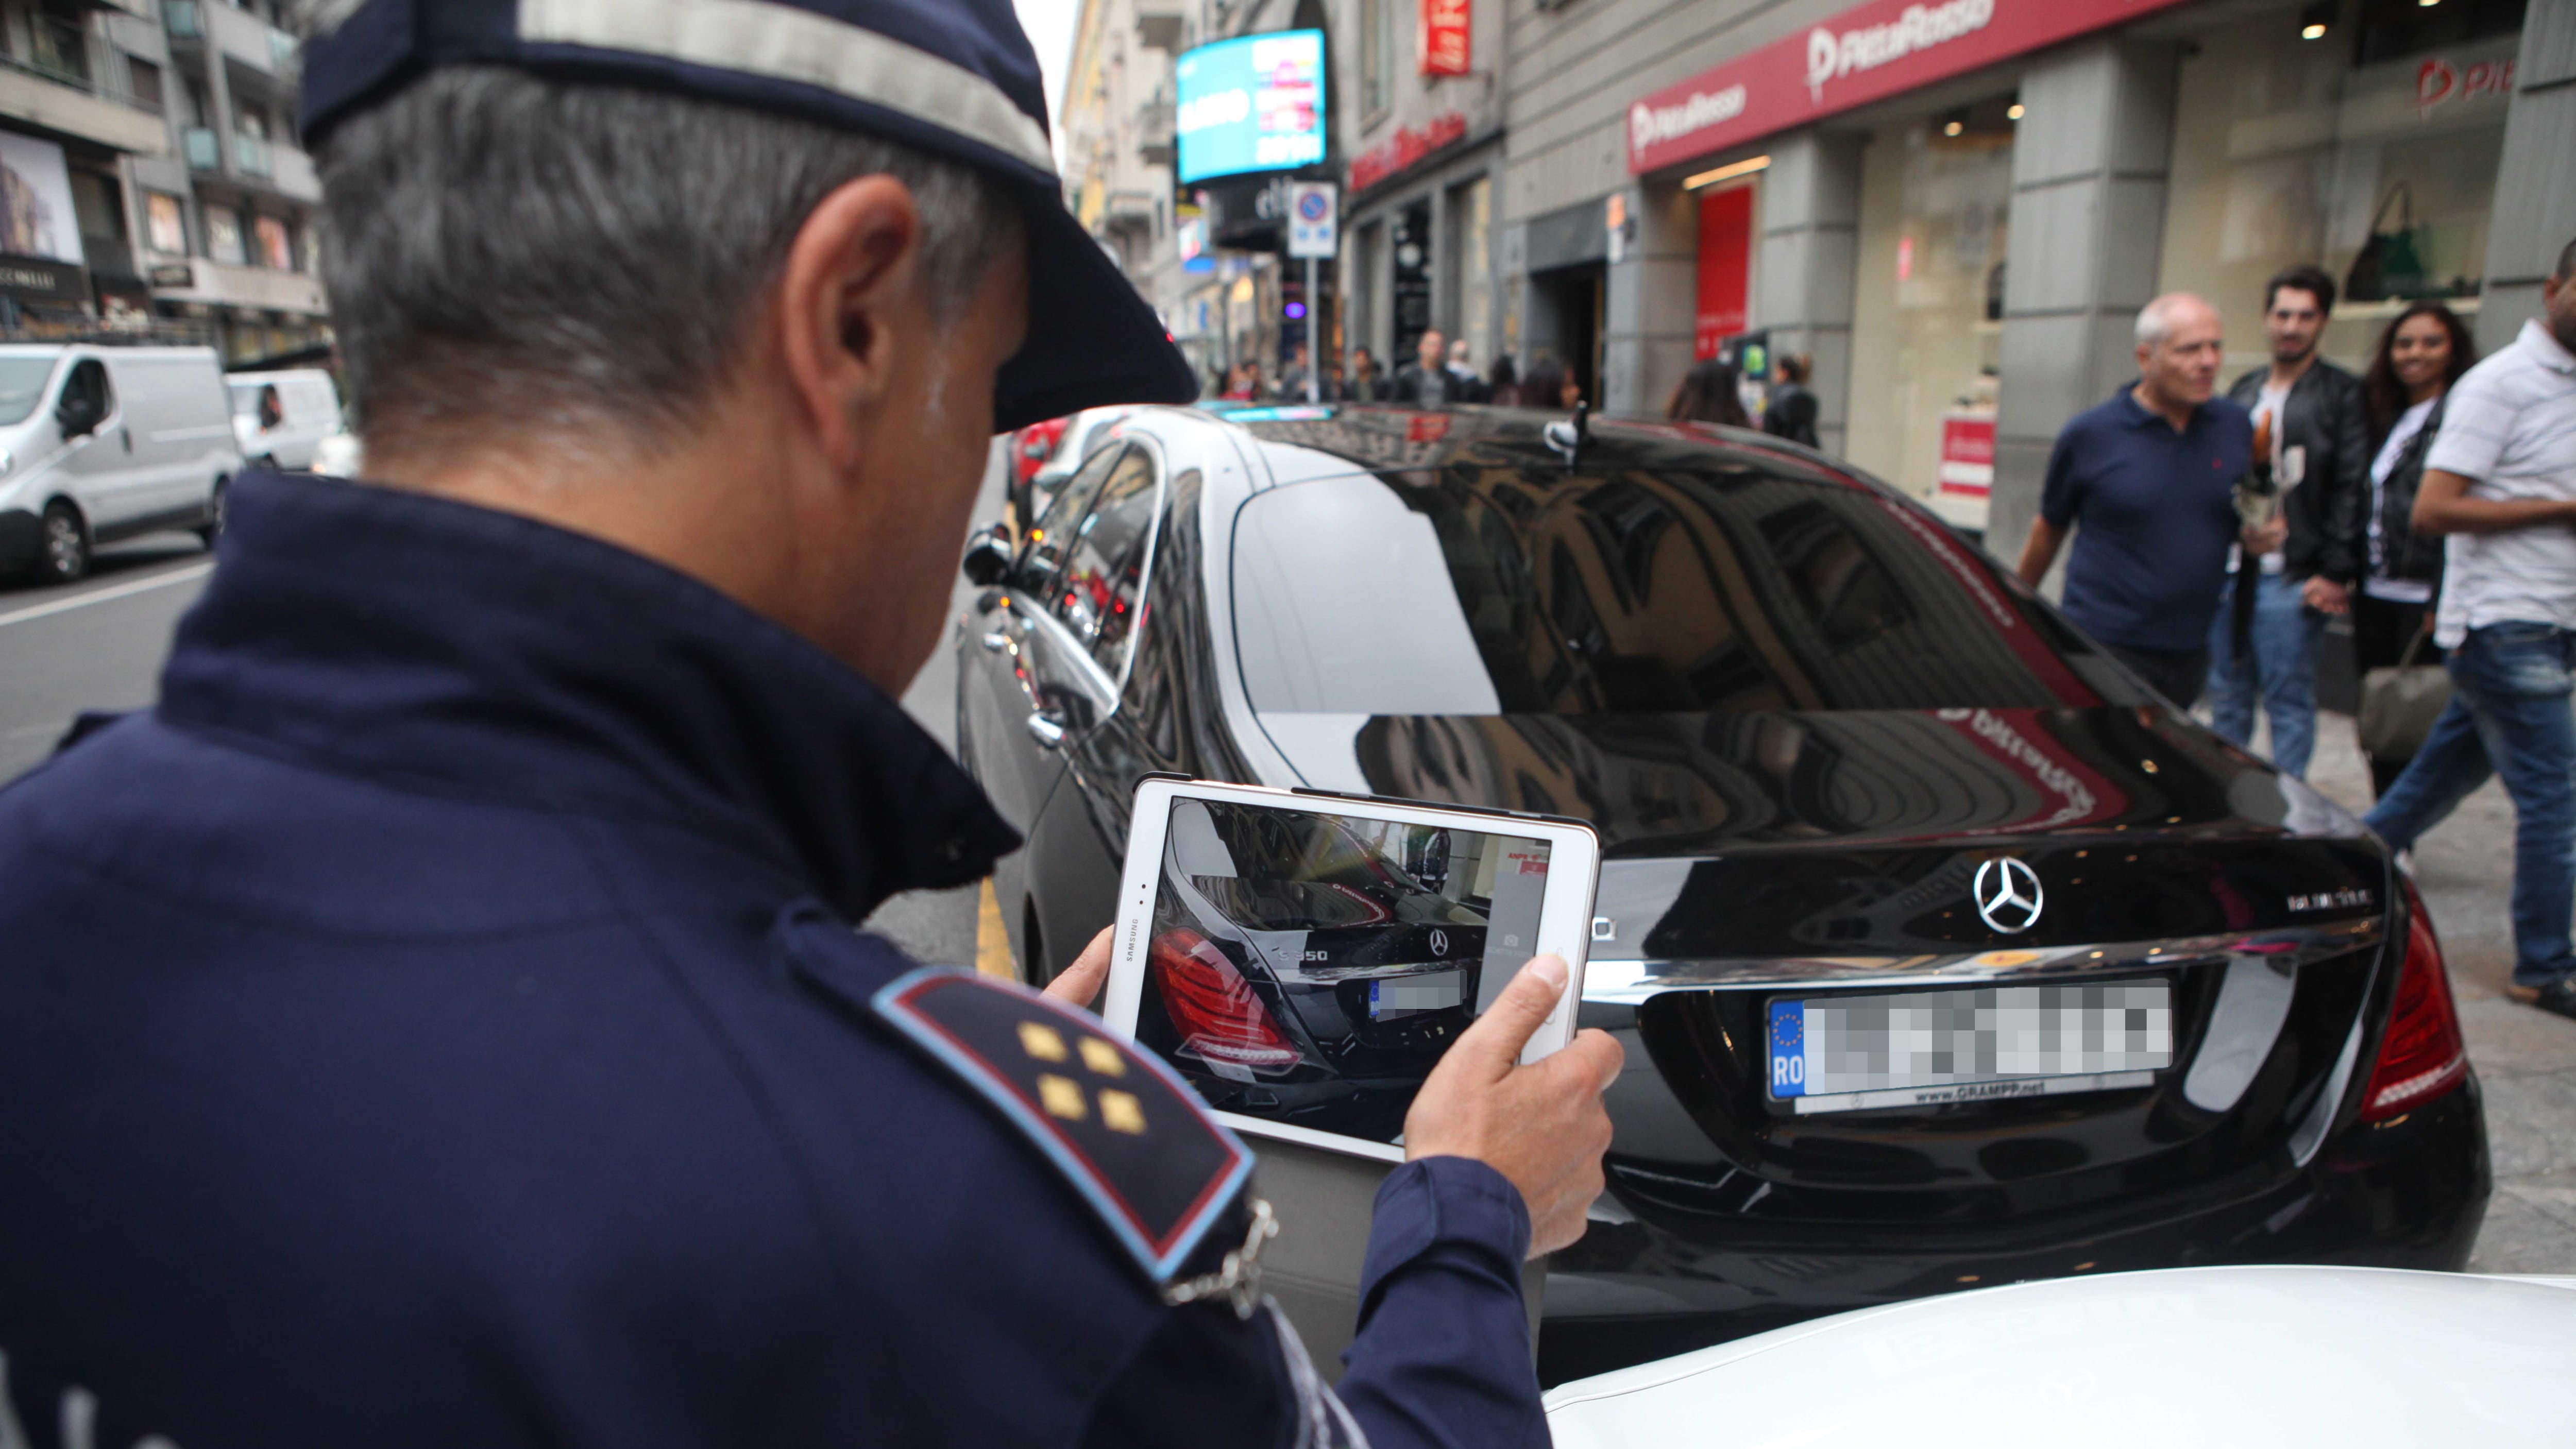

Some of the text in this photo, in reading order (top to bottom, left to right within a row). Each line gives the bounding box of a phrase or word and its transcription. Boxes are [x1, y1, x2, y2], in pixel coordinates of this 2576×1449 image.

[1126, 919, 1138, 962] SAMSUNG
[1295, 950, 1328, 961] 350
[1773, 1055, 1803, 1086] RO
[1916, 1080, 2046, 1102] www.GRAMPP.net
